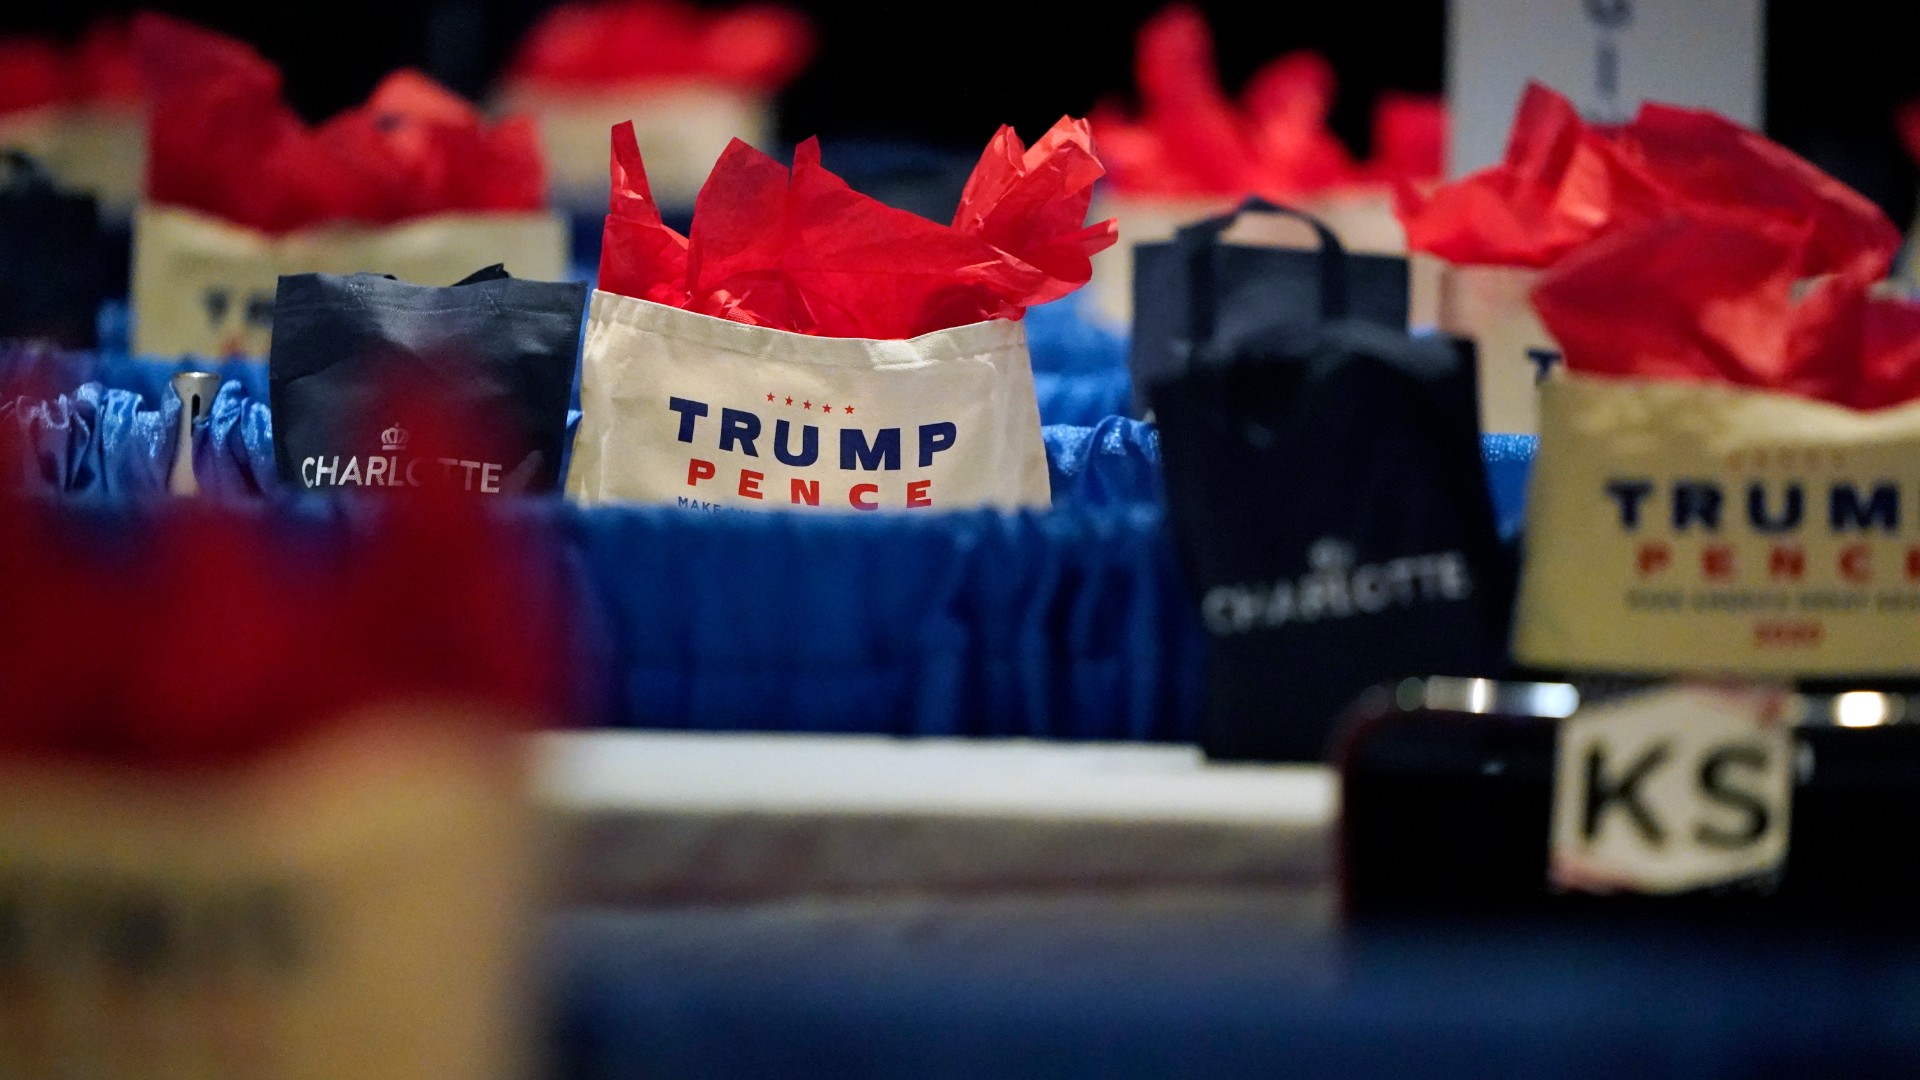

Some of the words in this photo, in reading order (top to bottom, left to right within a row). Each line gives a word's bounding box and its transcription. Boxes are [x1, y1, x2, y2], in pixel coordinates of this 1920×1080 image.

[669, 396, 957, 471] TRUMP
[687, 458, 932, 511] PENCE
[1604, 478, 1920, 533] TRUM
[1583, 742, 1768, 848] KS
